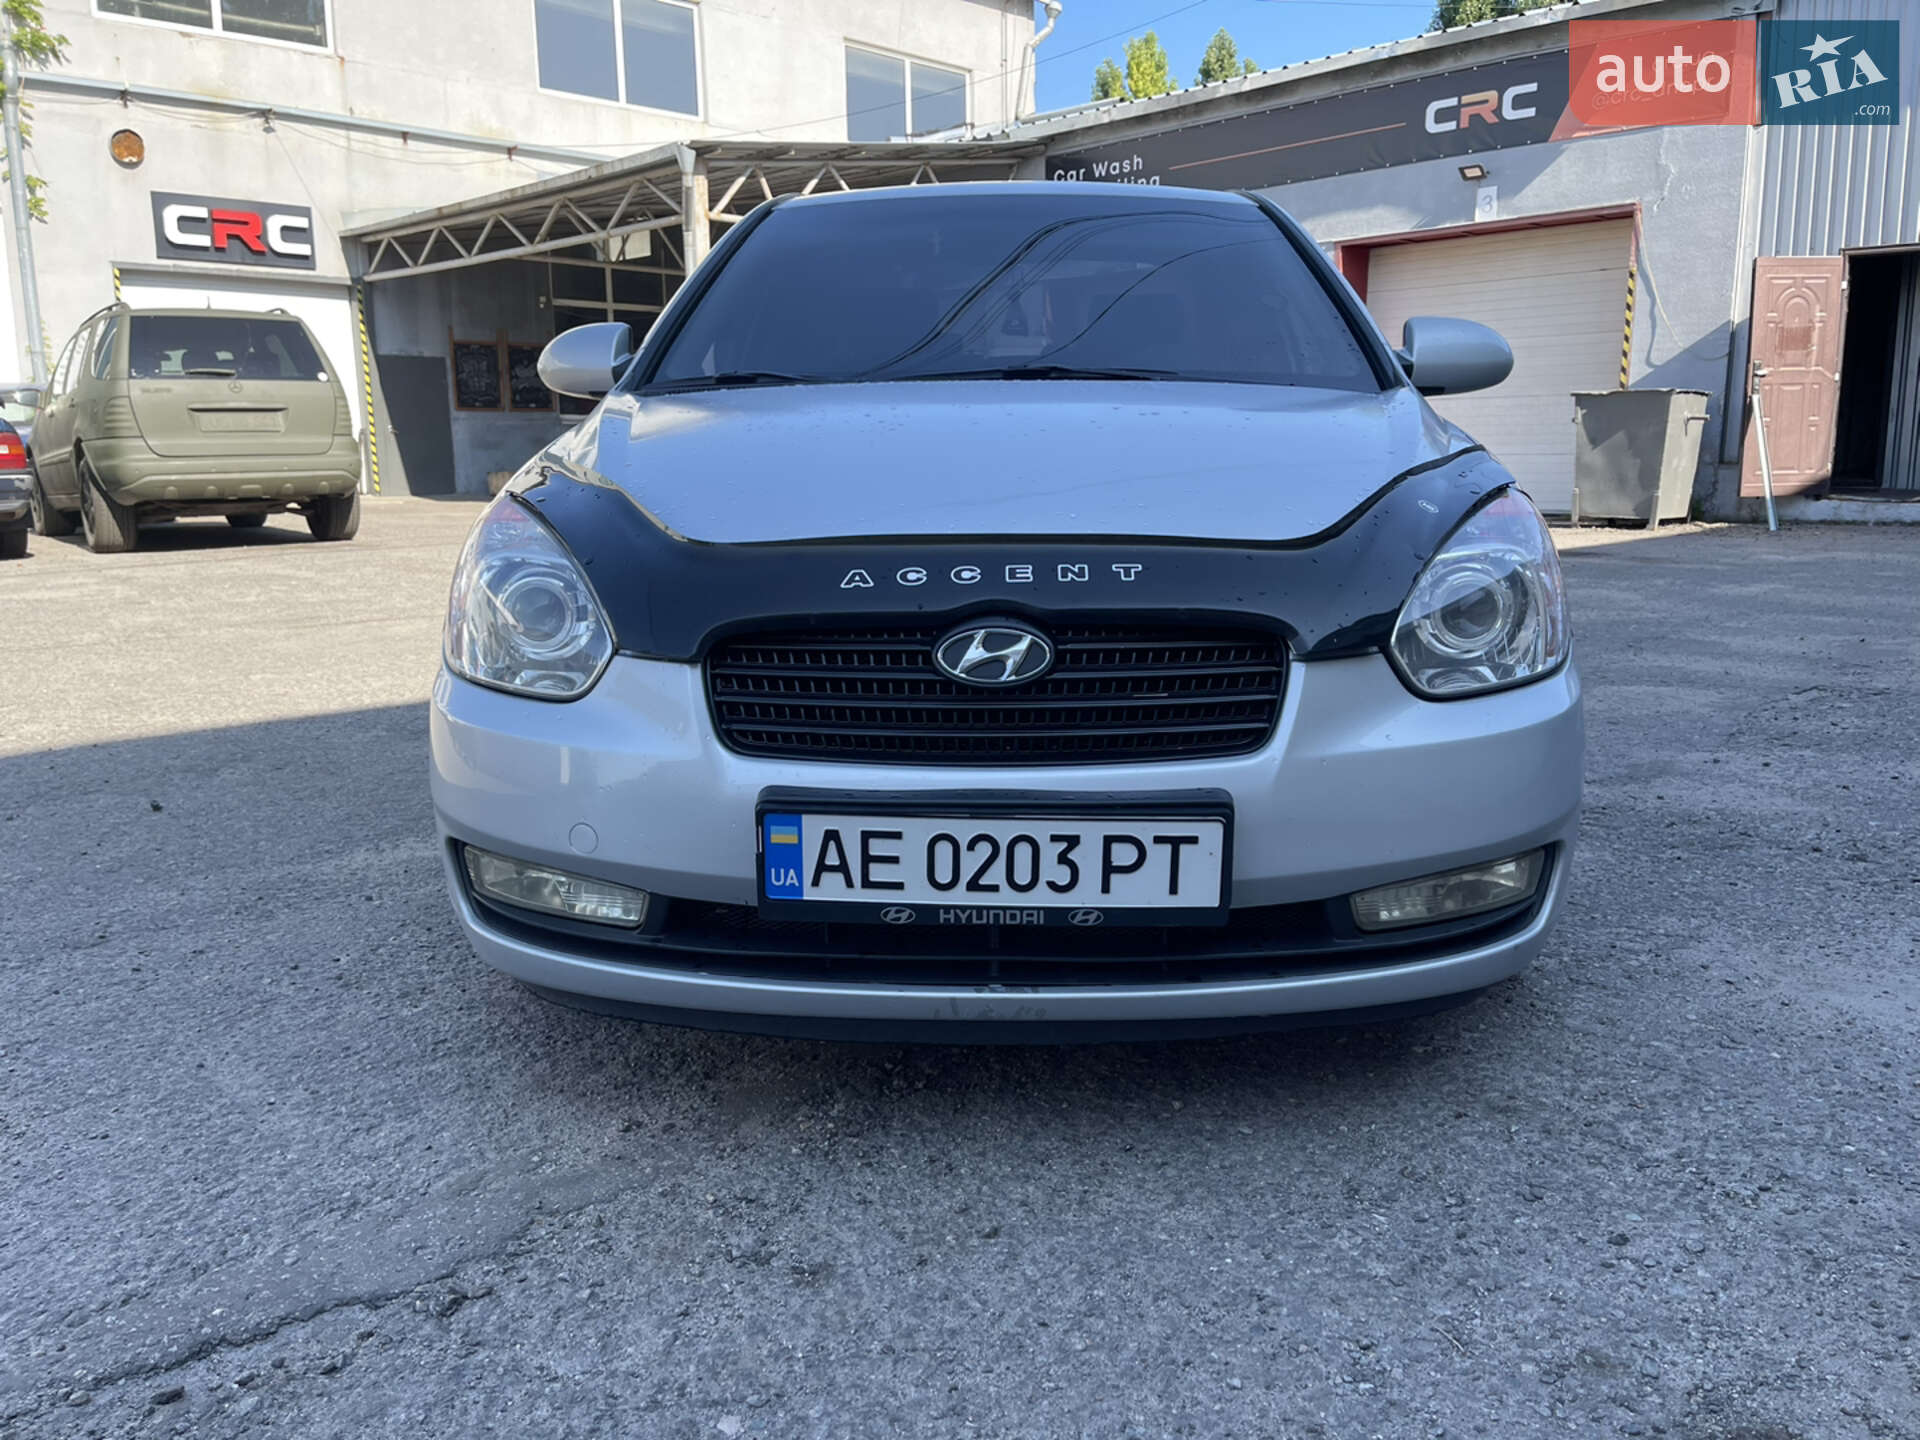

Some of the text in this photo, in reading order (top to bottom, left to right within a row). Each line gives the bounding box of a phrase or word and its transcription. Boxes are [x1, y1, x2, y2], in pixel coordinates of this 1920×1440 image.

[1425, 82, 1538, 134] CRC
[1053, 154, 1143, 182] Car Wash
[162, 204, 313, 257] CRC
[840, 564, 1142, 589] ACCENT
[811, 828, 1200, 896] AE 0203 PT
[770, 867, 800, 888] UA
[939, 908, 1045, 925] HYUNDAI
